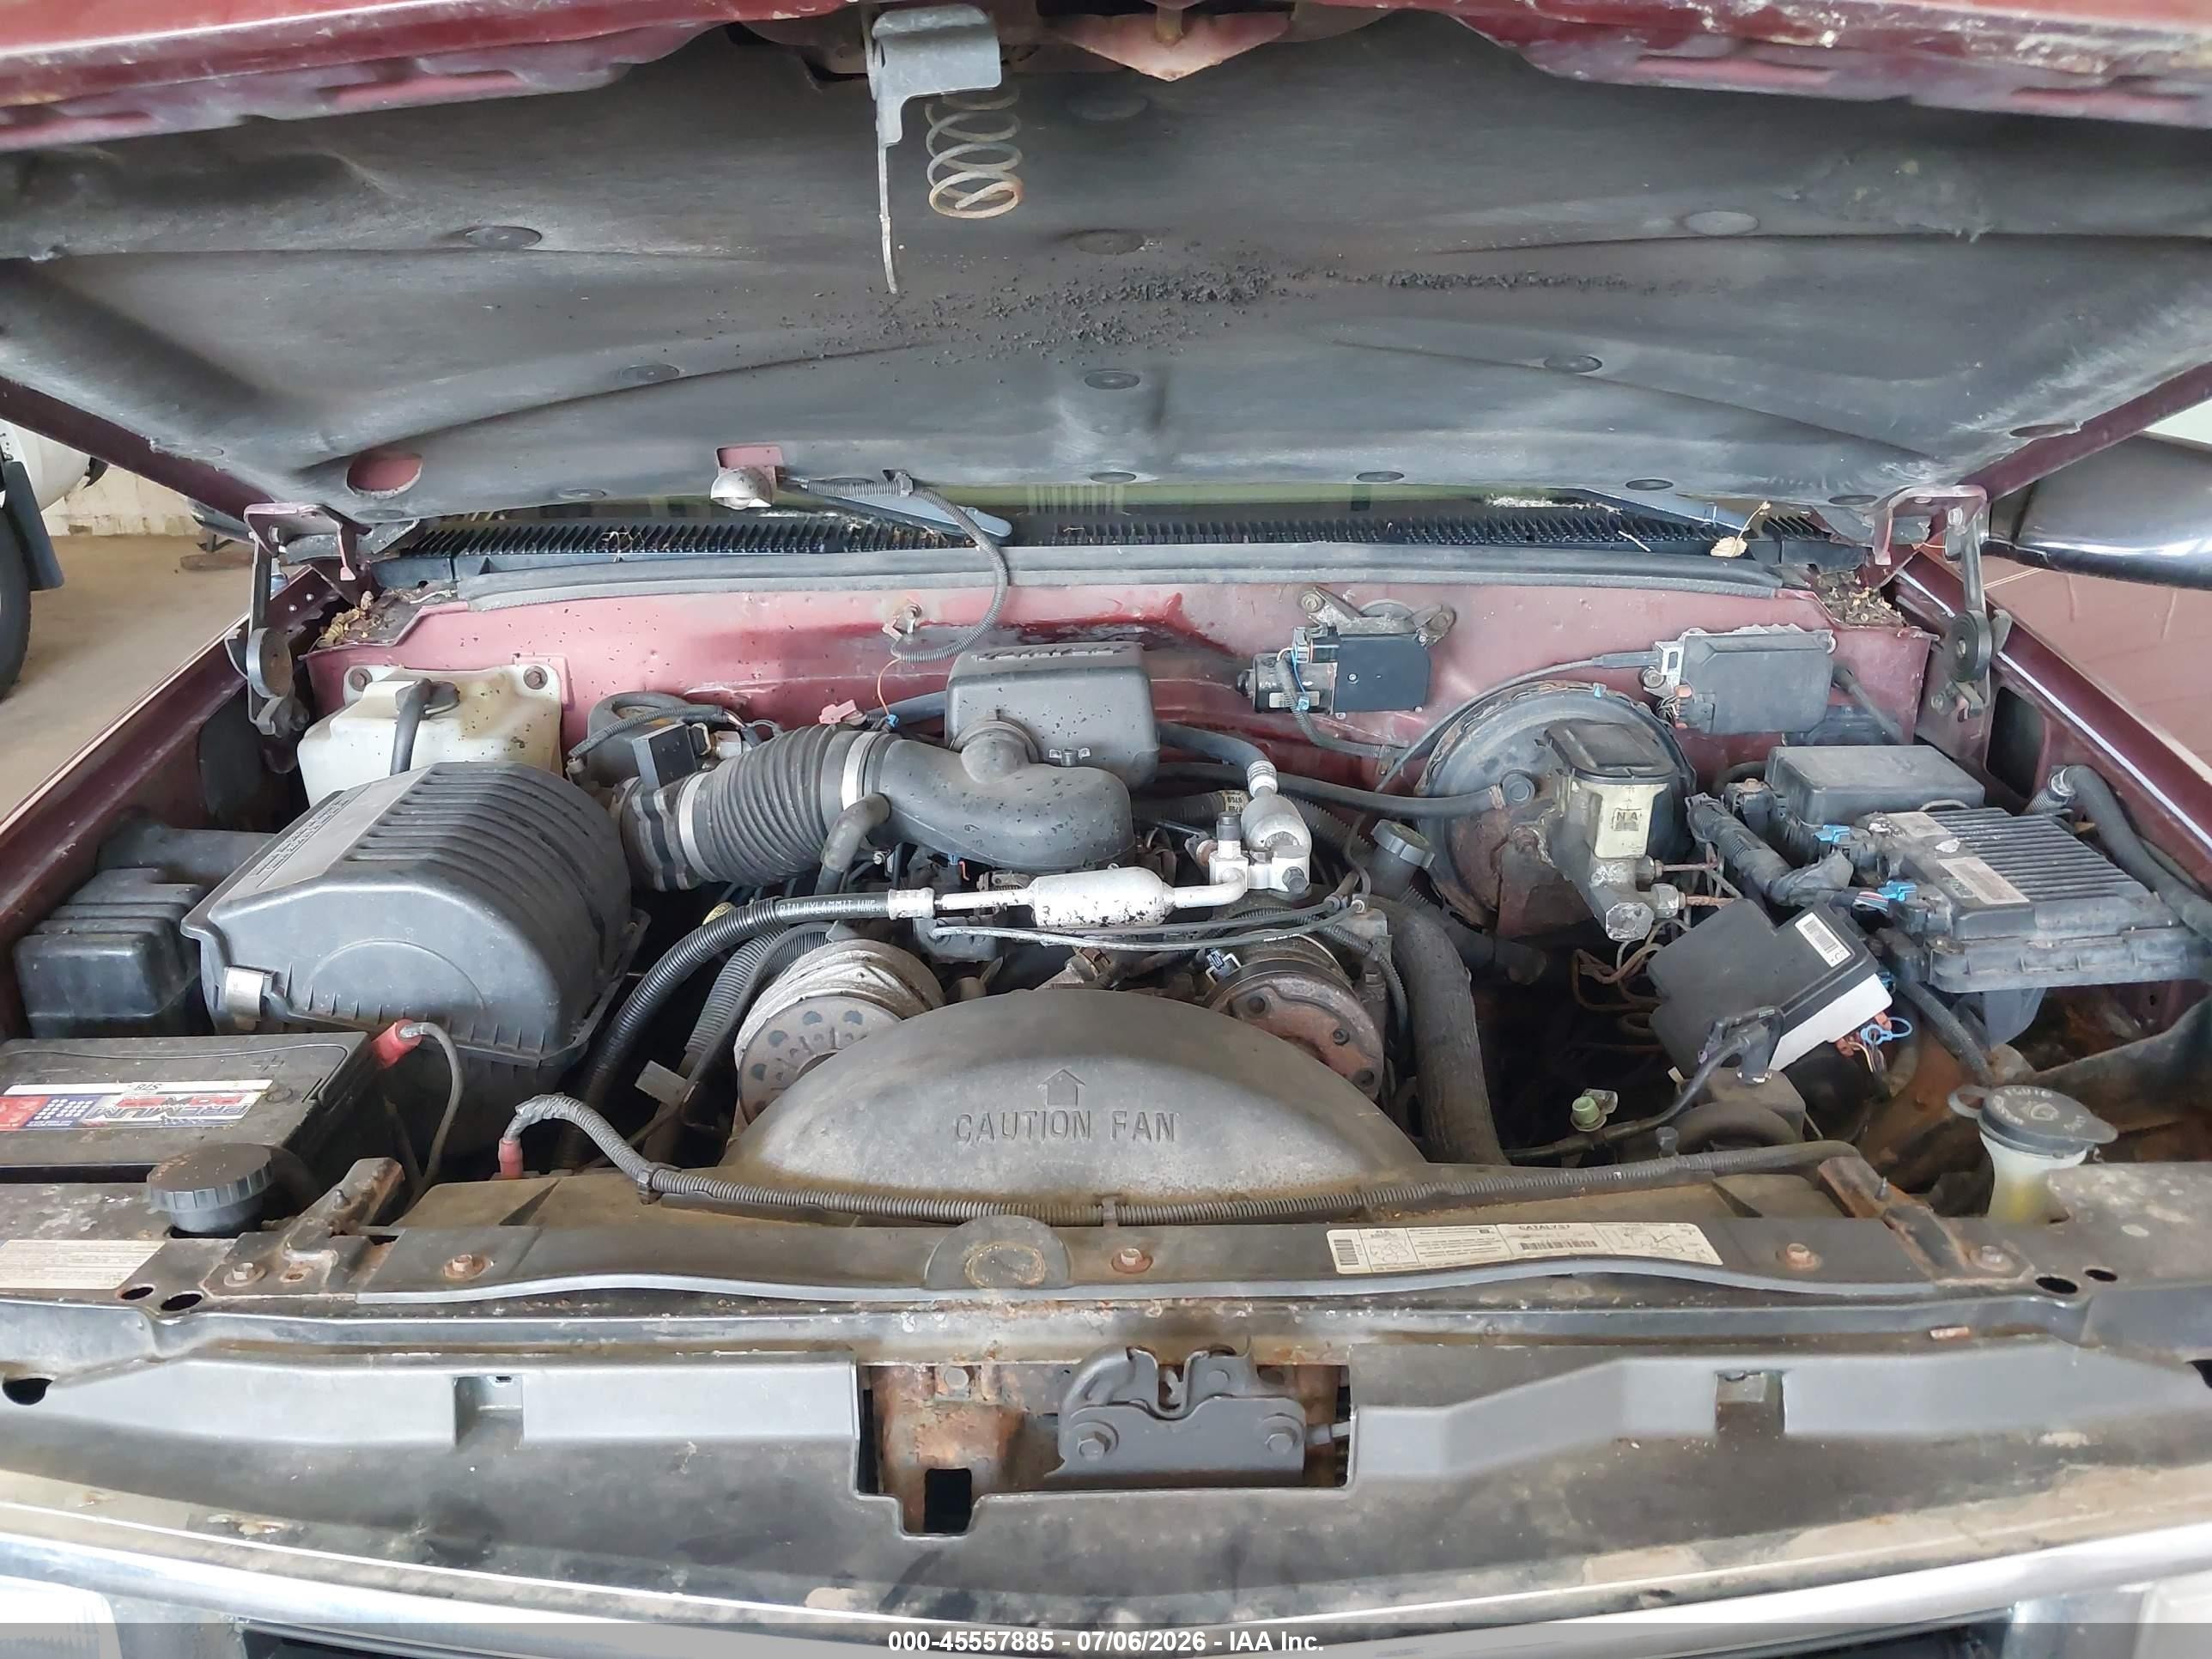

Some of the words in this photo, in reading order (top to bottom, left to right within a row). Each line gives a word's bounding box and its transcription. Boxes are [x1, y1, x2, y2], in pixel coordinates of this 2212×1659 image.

[115, 1095, 246, 1108] POWER
[85, 1103, 251, 1120] PREMIUM
[956, 1109, 1091, 1142] CAUTION
[1111, 1109, 1176, 1142] FAN
